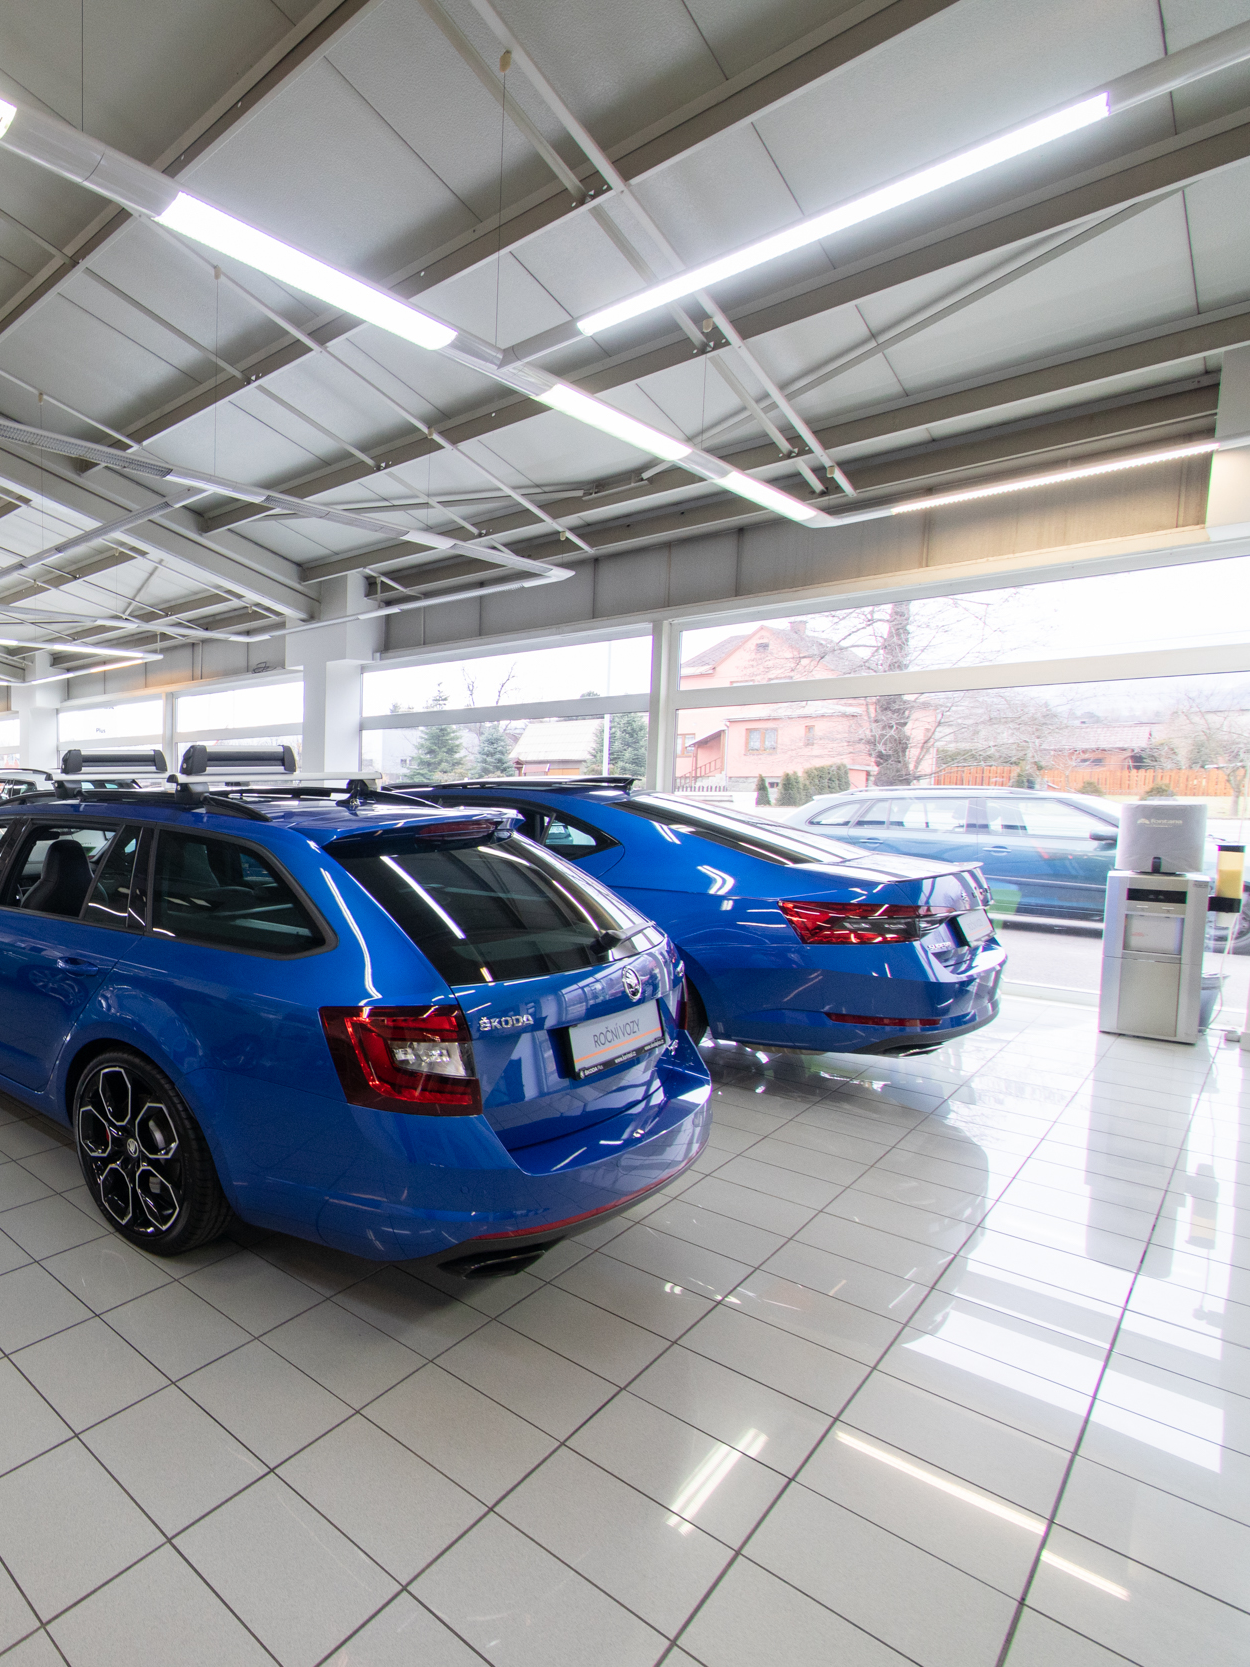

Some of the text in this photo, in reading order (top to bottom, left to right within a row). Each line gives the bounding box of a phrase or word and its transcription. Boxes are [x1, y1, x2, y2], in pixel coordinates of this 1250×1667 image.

[478, 1014, 534, 1032] ŠKODA
[593, 1018, 640, 1048] ROČNÍ VOZY
